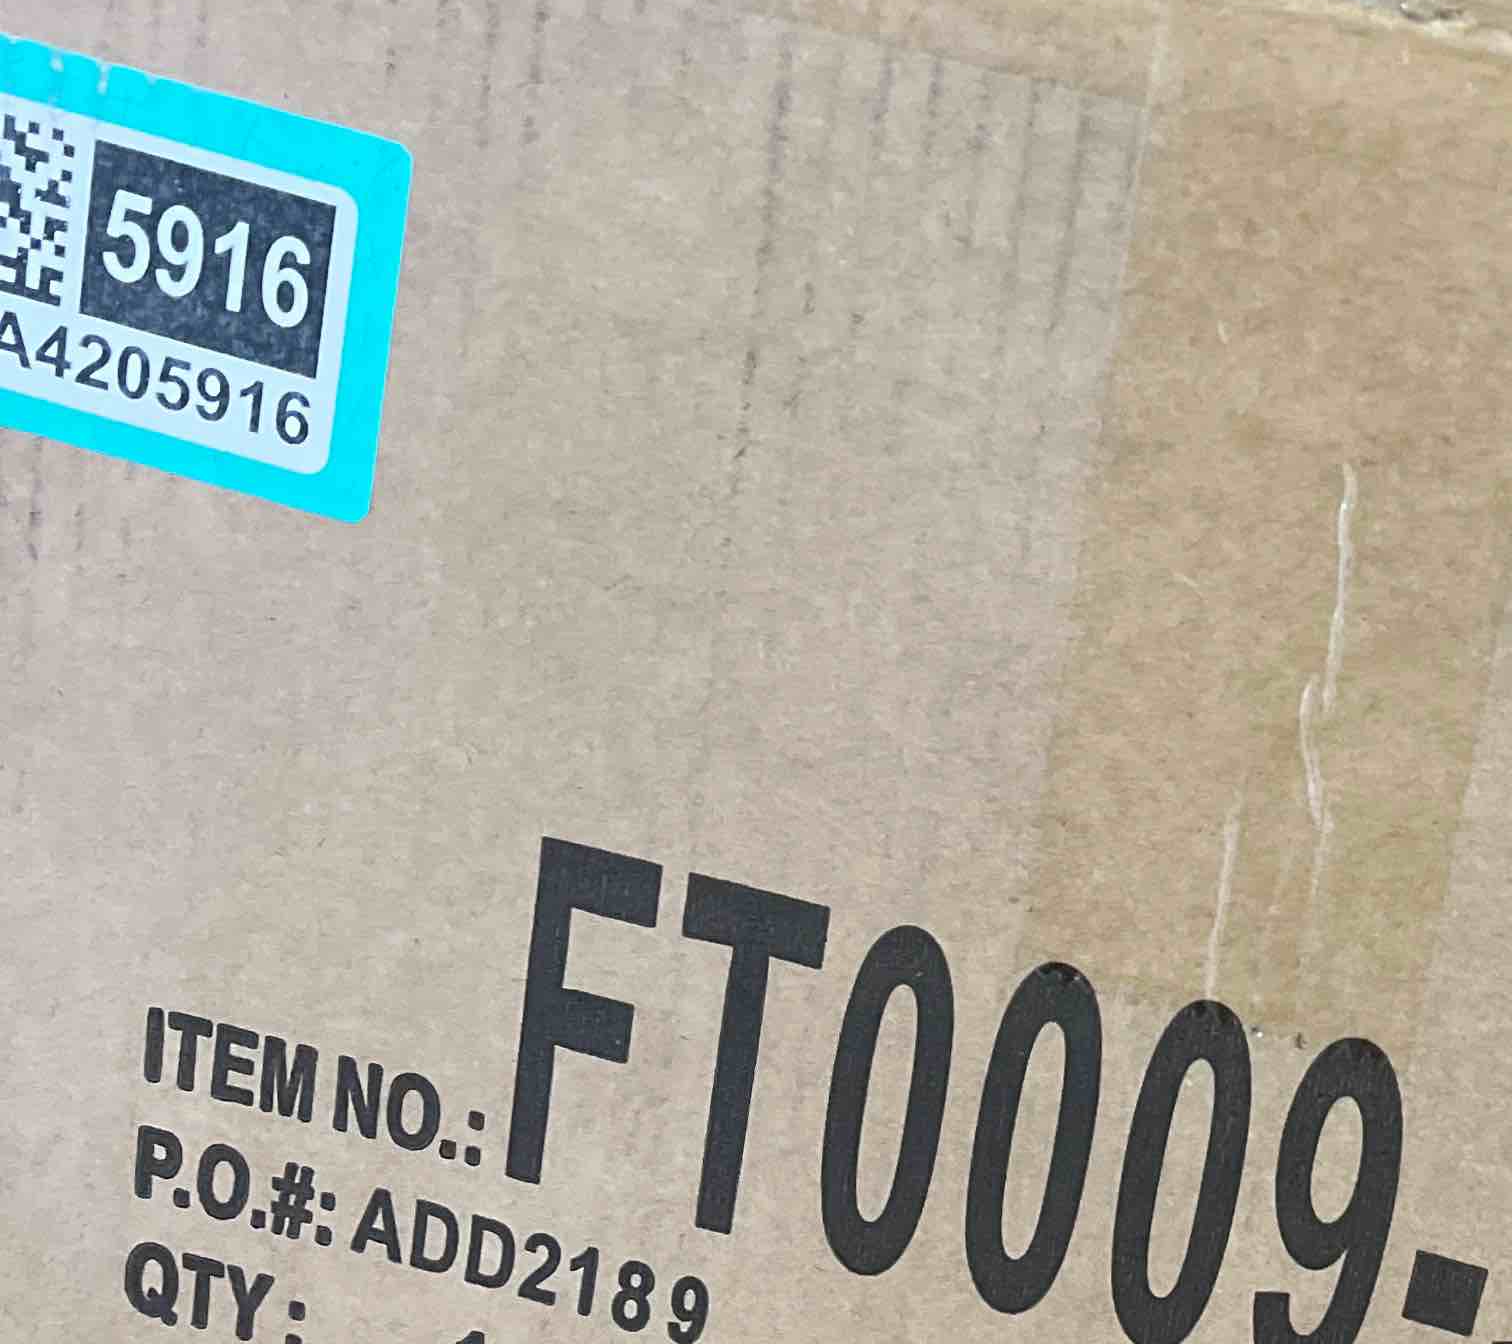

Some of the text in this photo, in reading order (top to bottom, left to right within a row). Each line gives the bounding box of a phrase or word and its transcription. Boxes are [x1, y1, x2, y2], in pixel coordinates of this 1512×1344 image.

[102, 189, 312, 329] 5916
[0, 311, 312, 445] A4205916
[144, 1007, 319, 1122] ITEM
[333, 1056, 485, 1166] NO.:
[134, 1125, 709, 1344] P.O.#: ADD2189
